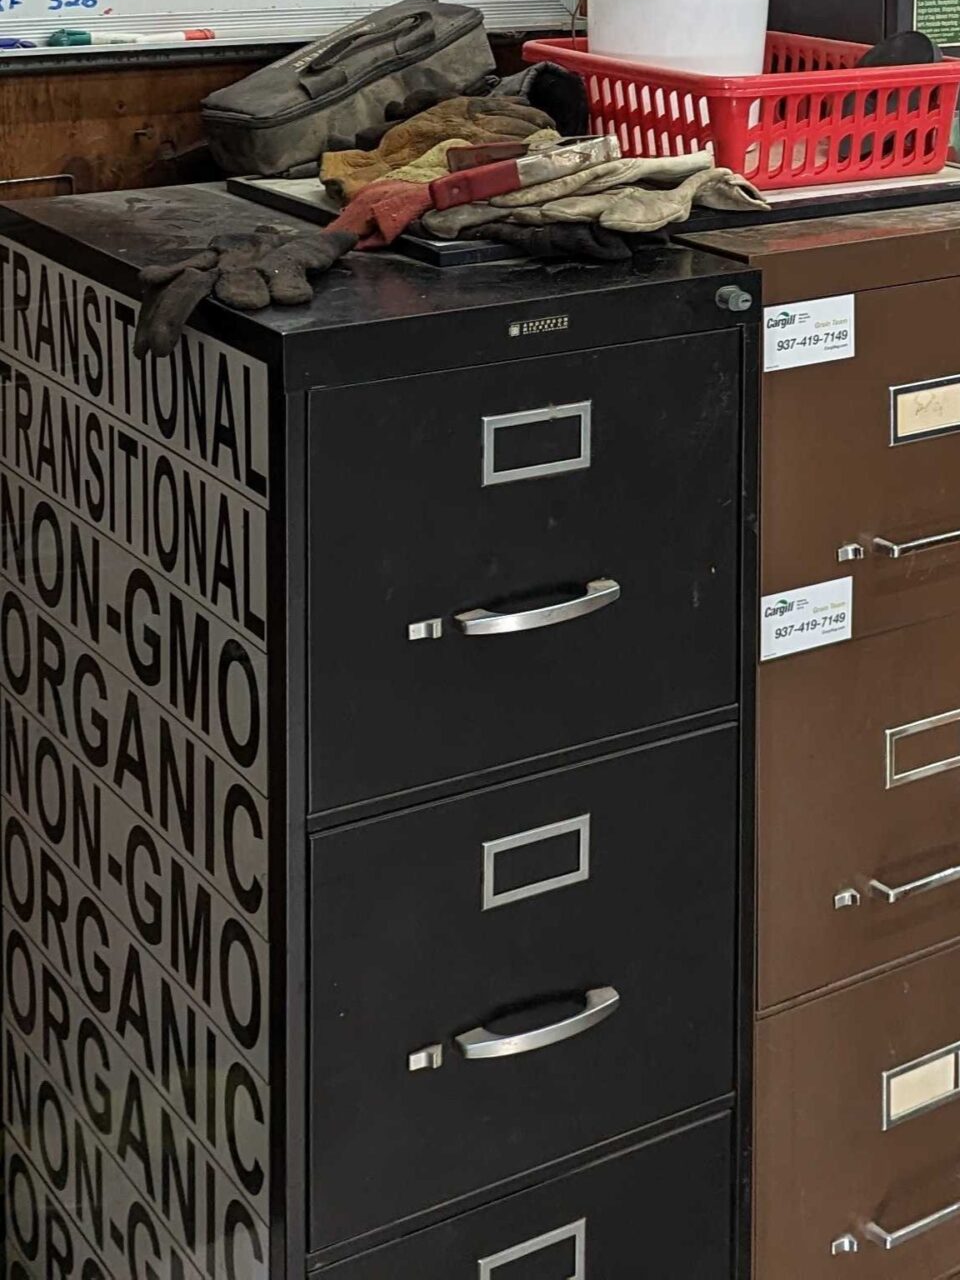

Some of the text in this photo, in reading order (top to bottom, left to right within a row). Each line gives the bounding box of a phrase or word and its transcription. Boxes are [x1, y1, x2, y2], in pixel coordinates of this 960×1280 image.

[0, 246, 267, 499] TRANSITIONAL
[767, 313, 797, 329] Cargill
[777, 329, 848, 352] 937-419-7149
[0, 359, 267, 642] TRANSITIONAL
[1, 472, 261, 769] NON-GMO
[764, 601, 795, 618] Cargill
[775, 611, 846, 640] 937-419-7149
[1, 591, 264, 915] ORGANIC
[4, 697, 262, 1050] NON-GMO
[4, 815, 265, 1197] ORGANIC
